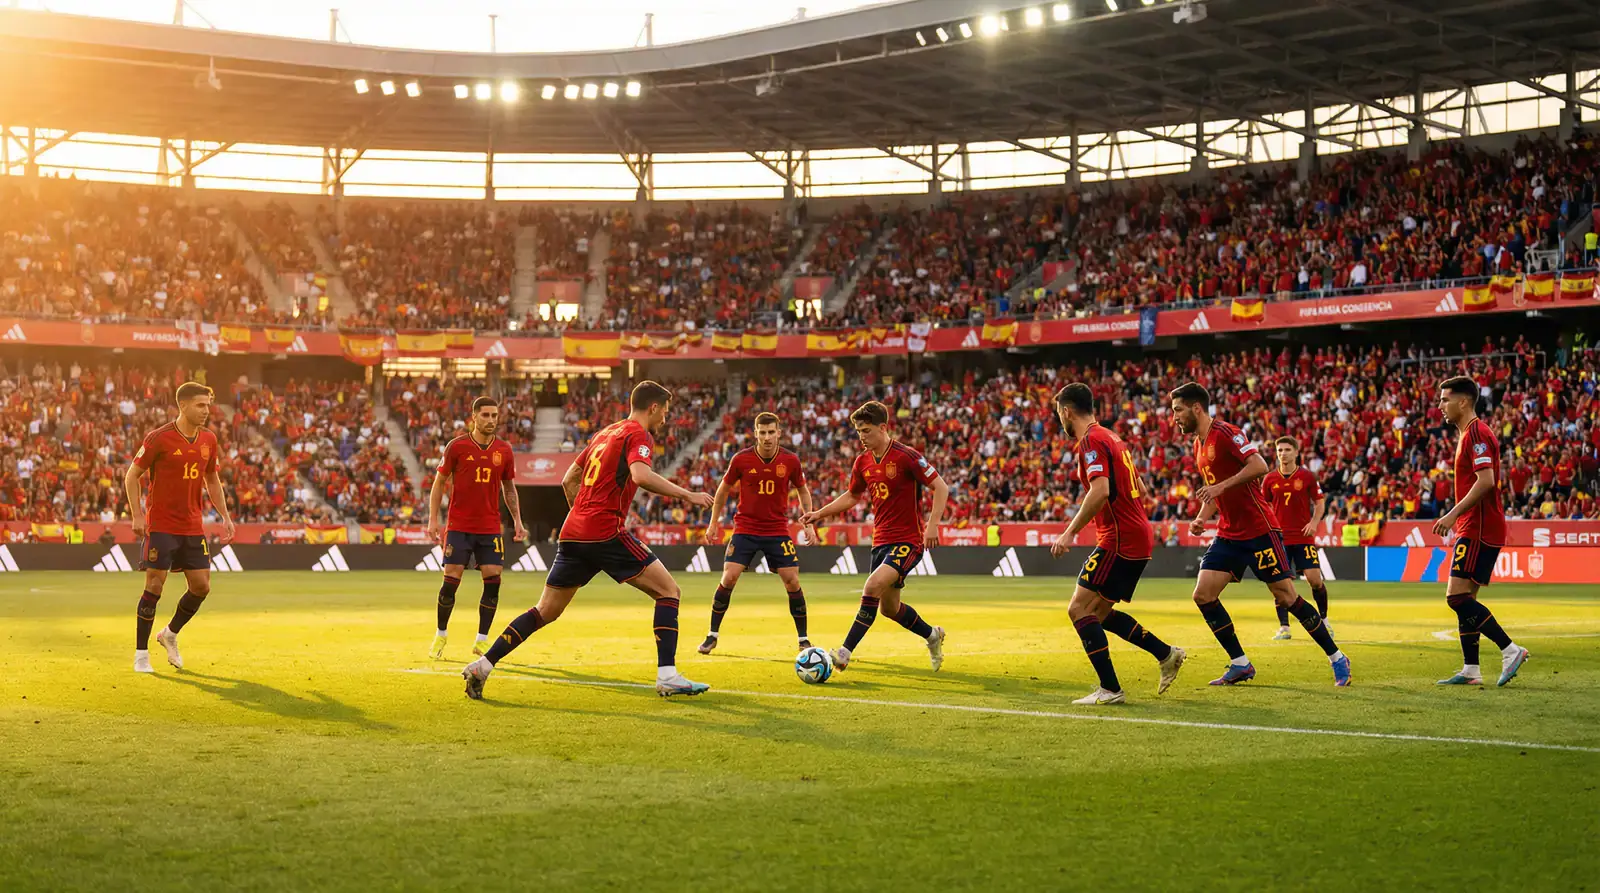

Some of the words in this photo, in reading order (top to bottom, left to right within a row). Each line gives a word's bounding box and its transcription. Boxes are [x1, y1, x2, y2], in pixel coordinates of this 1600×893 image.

[182, 462, 199, 480] 16
[584, 443, 607, 487] 8
[474, 466, 492, 483] 13
[758, 479, 776, 495] 10
[1283, 492, 1292, 506] 7
[1554, 532, 1600, 544] SEAT
[780, 540, 797, 556] 18
[889, 545, 911, 558] 19
[1455, 543, 1467, 562] 9
[1254, 547, 1278, 570] 23
